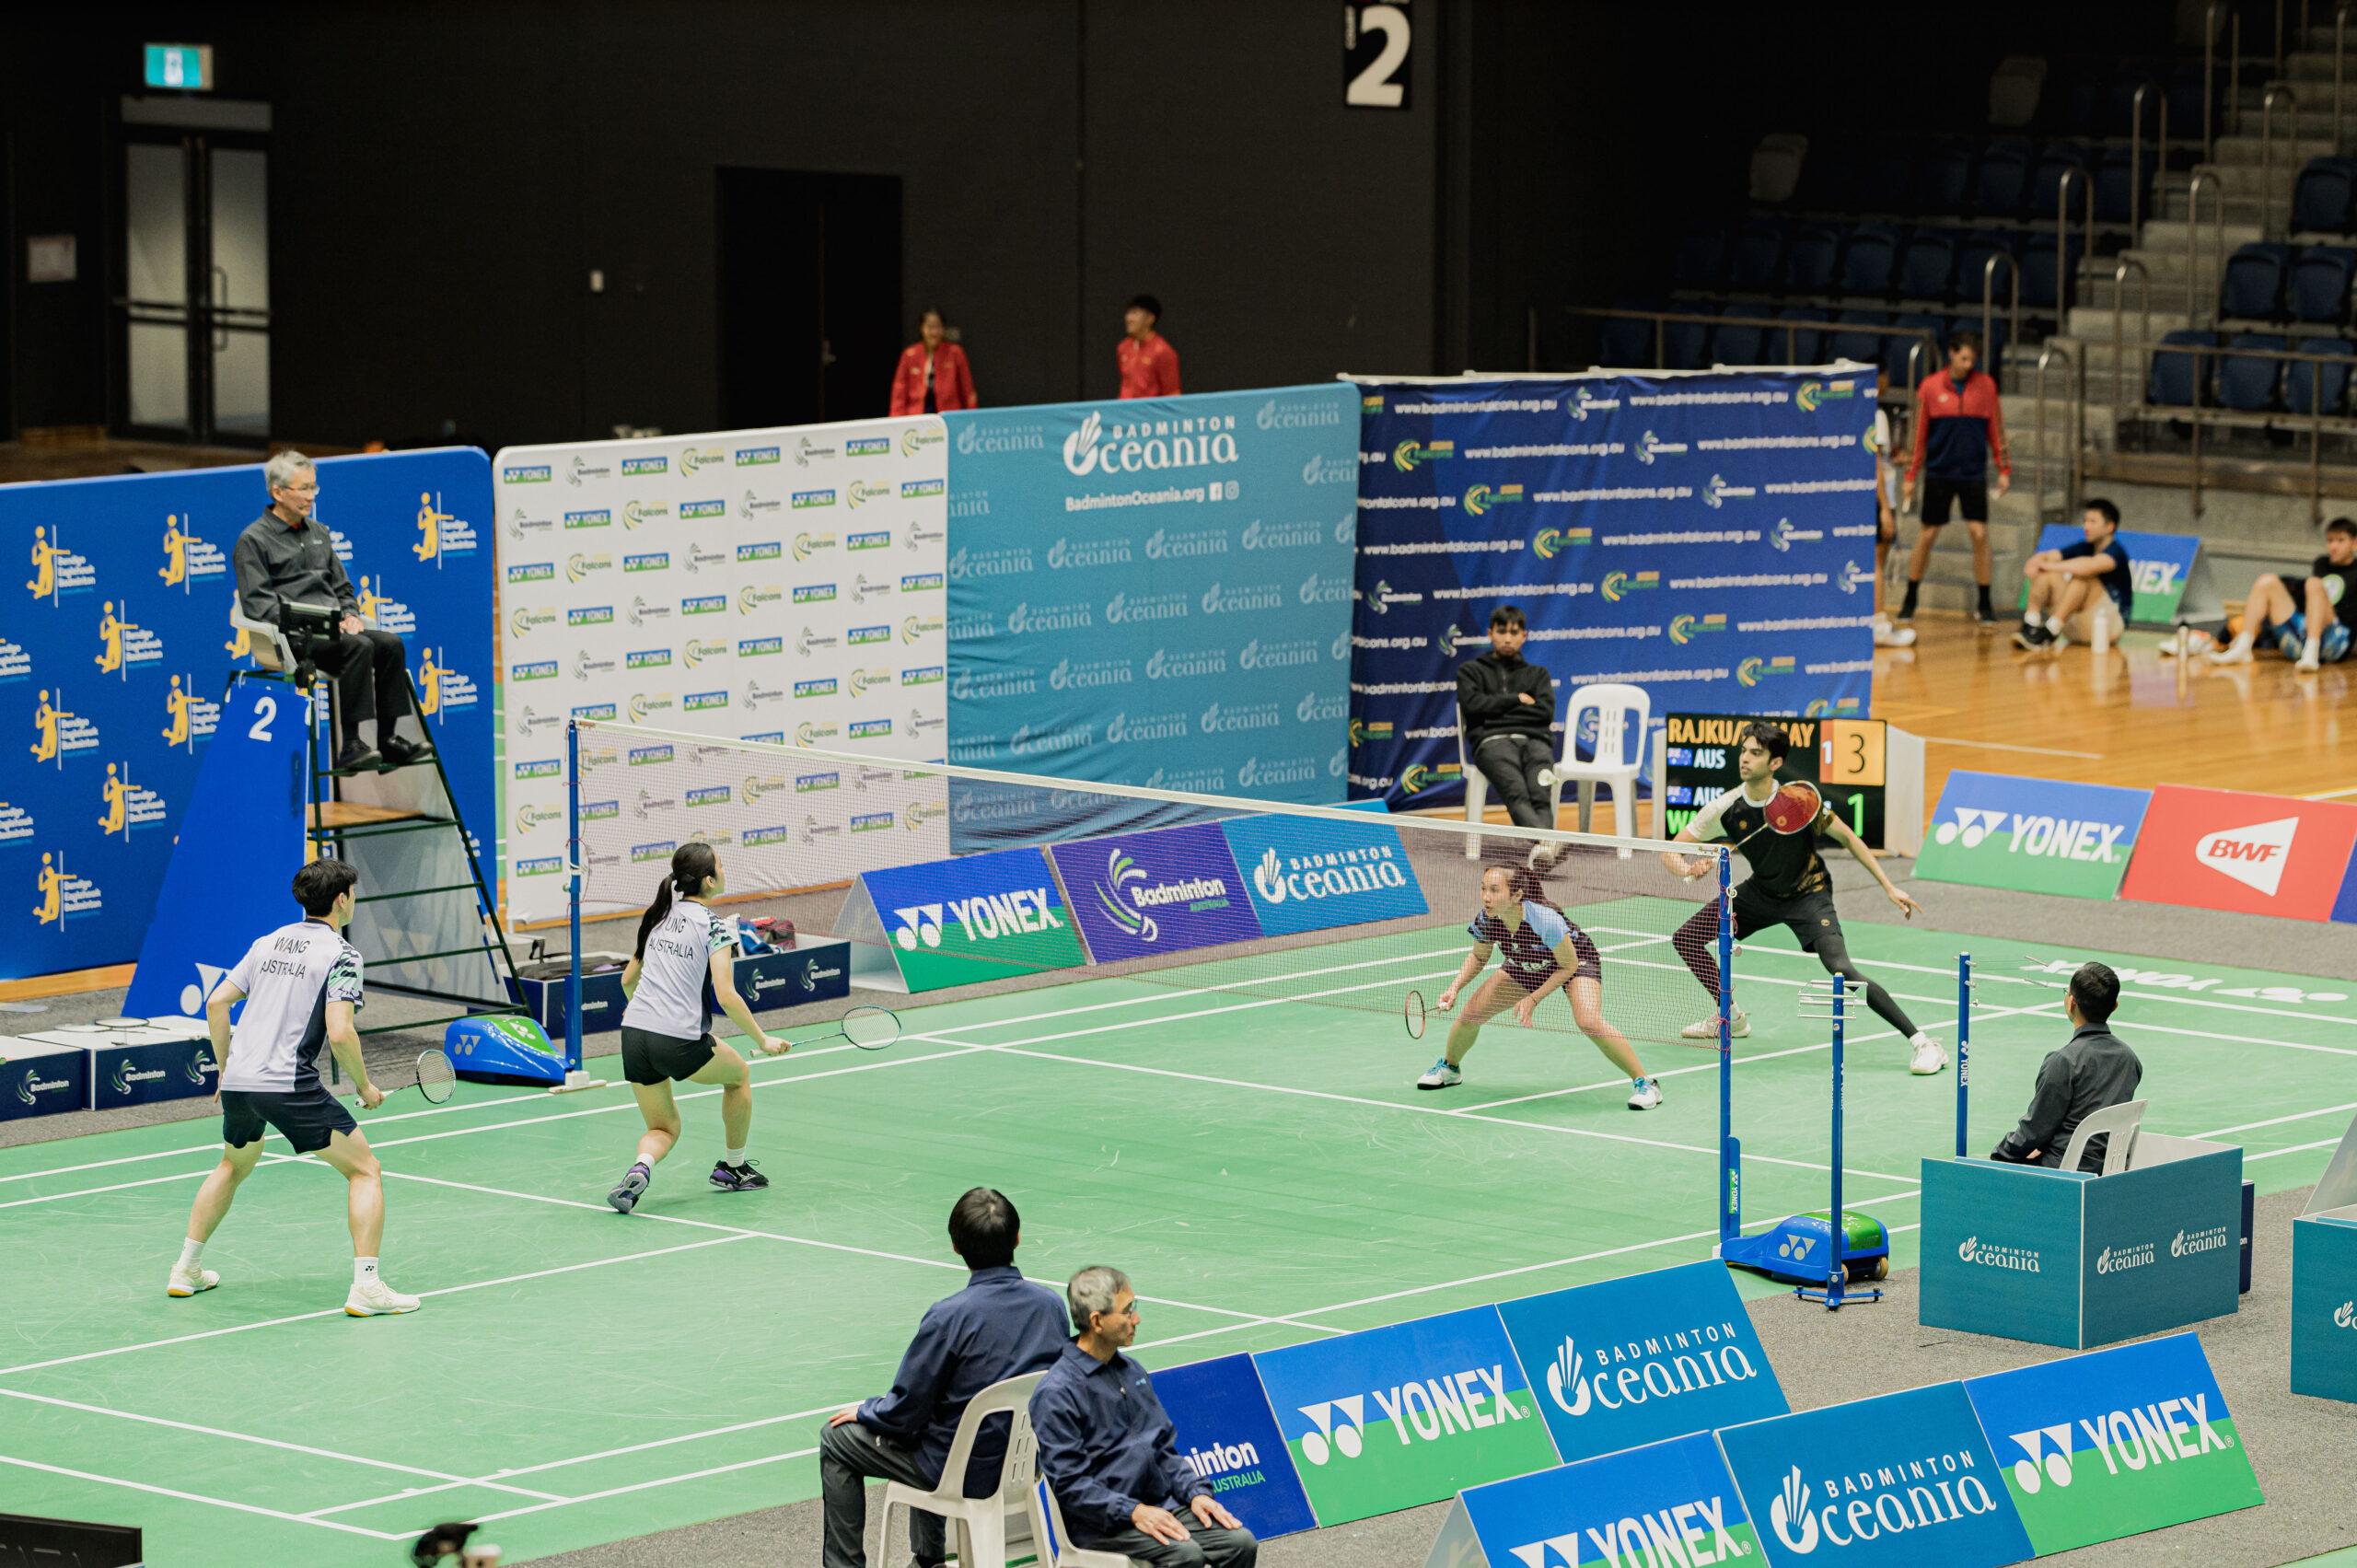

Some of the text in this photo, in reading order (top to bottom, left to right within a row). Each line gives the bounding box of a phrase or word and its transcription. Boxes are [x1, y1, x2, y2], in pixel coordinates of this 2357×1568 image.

[1346, 5, 1411, 107] 2
[1112, 415, 1236, 440] BADMINTON
[863, 440, 888, 454] YONEX
[753, 448, 778, 464] YONEX
[640, 459, 666, 473] YONEX
[522, 468, 549, 481] YONEX
[918, 481, 942, 495] YONEX
[809, 492, 834, 505] YONEX
[1065, 486, 1204, 511] BadmintonOceania.org
[697, 502, 723, 517] YONEX
[583, 511, 609, 527] YONEX
[864, 533, 888, 548] YONEX
[754, 544, 779, 559] YONEX
[642, 554, 668, 569] YONEX
[526, 564, 552, 580] YONEX
[2129, 559, 2180, 595] NEX
[917, 575, 941, 589] YONEX
[810, 586, 834, 601] YONEX
[699, 597, 725, 612] YONEX
[586, 608, 611, 623] YONEX
[865, 627, 888, 642] YONEX
[755, 639, 781, 655] YONEX
[644, 651, 669, 666] YONEX
[530, 663, 556, 679] YONEX
[918, 668, 942, 683] YONEX
[811, 679, 836, 695] YONEX
[701, 692, 726, 708] YONEX
[249, 696, 277, 742] 2
[588, 705, 614, 720] YONEX
[865, 721, 889, 737] YONEX
[1693, 748, 1726, 770] AUS
[1821, 740, 1832, 764] 1
[1848, 734, 1865, 773] 3
[533, 761, 559, 777] YONEX
[1693, 786, 1725, 807] AUS
[1847, 793, 1864, 837] 1
[2007, 813, 2124, 864] YONEX
[1290, 844, 1392, 871] BADMINTON
[2208, 839, 2282, 863] BWF
[534, 858, 561, 875] YONEX
[1131, 876, 1226, 908] Badminton
[947, 888, 1062, 942] YONEX
[273, 936, 310, 954] WANG
[647, 937, 693, 959] AUSTRALIA
[810, 967, 841, 980] Badminton
[755, 977, 786, 990] Badminton
[581, 1000, 608, 1011] dminton
[125, 1069, 166, 1082] Badminton
[1960, 1058, 1968, 1087] YONEX
[30, 1079, 69, 1093] Badminton
[2187, 1225, 2226, 1241] BADMINTON
[1981, 1242, 2039, 1259] BADMINTON
[2113, 1243, 2154, 1258] BADMINTON
[1596, 1322, 1736, 1365] BADMINTON
[1547, 1335, 1757, 1416] Oceania
[1372, 1364, 1523, 1446] YONEX
[2079, 1392, 2225, 1475] YONEX
[1213, 1469, 1266, 1493] USTRALIA
[1825, 1450, 1975, 1498] BADMINTON
[1770, 1465, 1997, 1554] Oceania
[1585, 1496, 1744, 1568] YONEX
